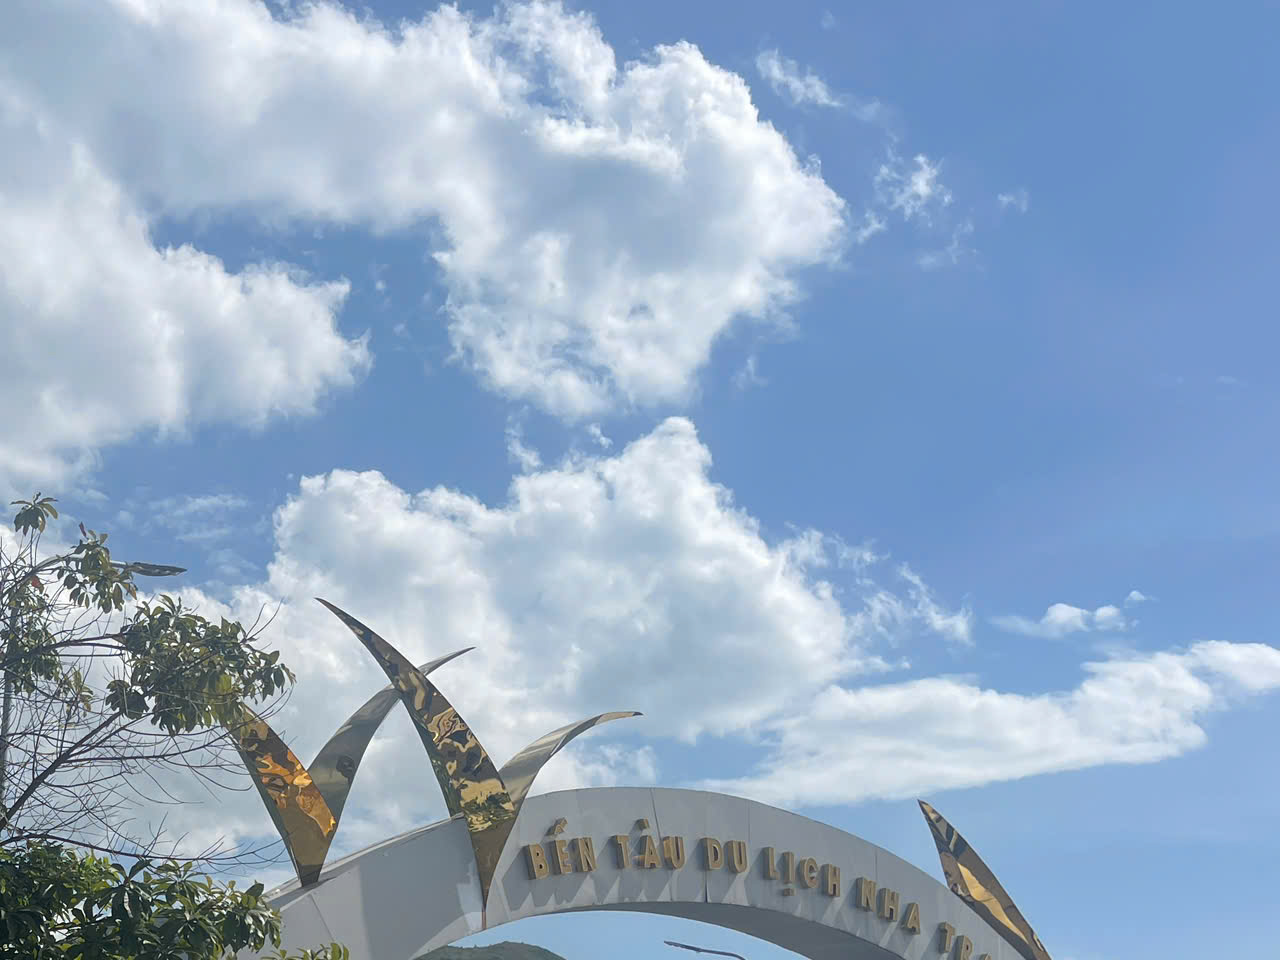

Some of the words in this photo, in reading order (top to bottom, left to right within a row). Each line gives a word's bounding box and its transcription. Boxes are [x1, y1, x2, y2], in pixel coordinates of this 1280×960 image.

[523, 817, 597, 880] BẾN
[700, 837, 748, 873] DU
[762, 846, 841, 897] LỊCH
[856, 873, 920, 935] NHA
